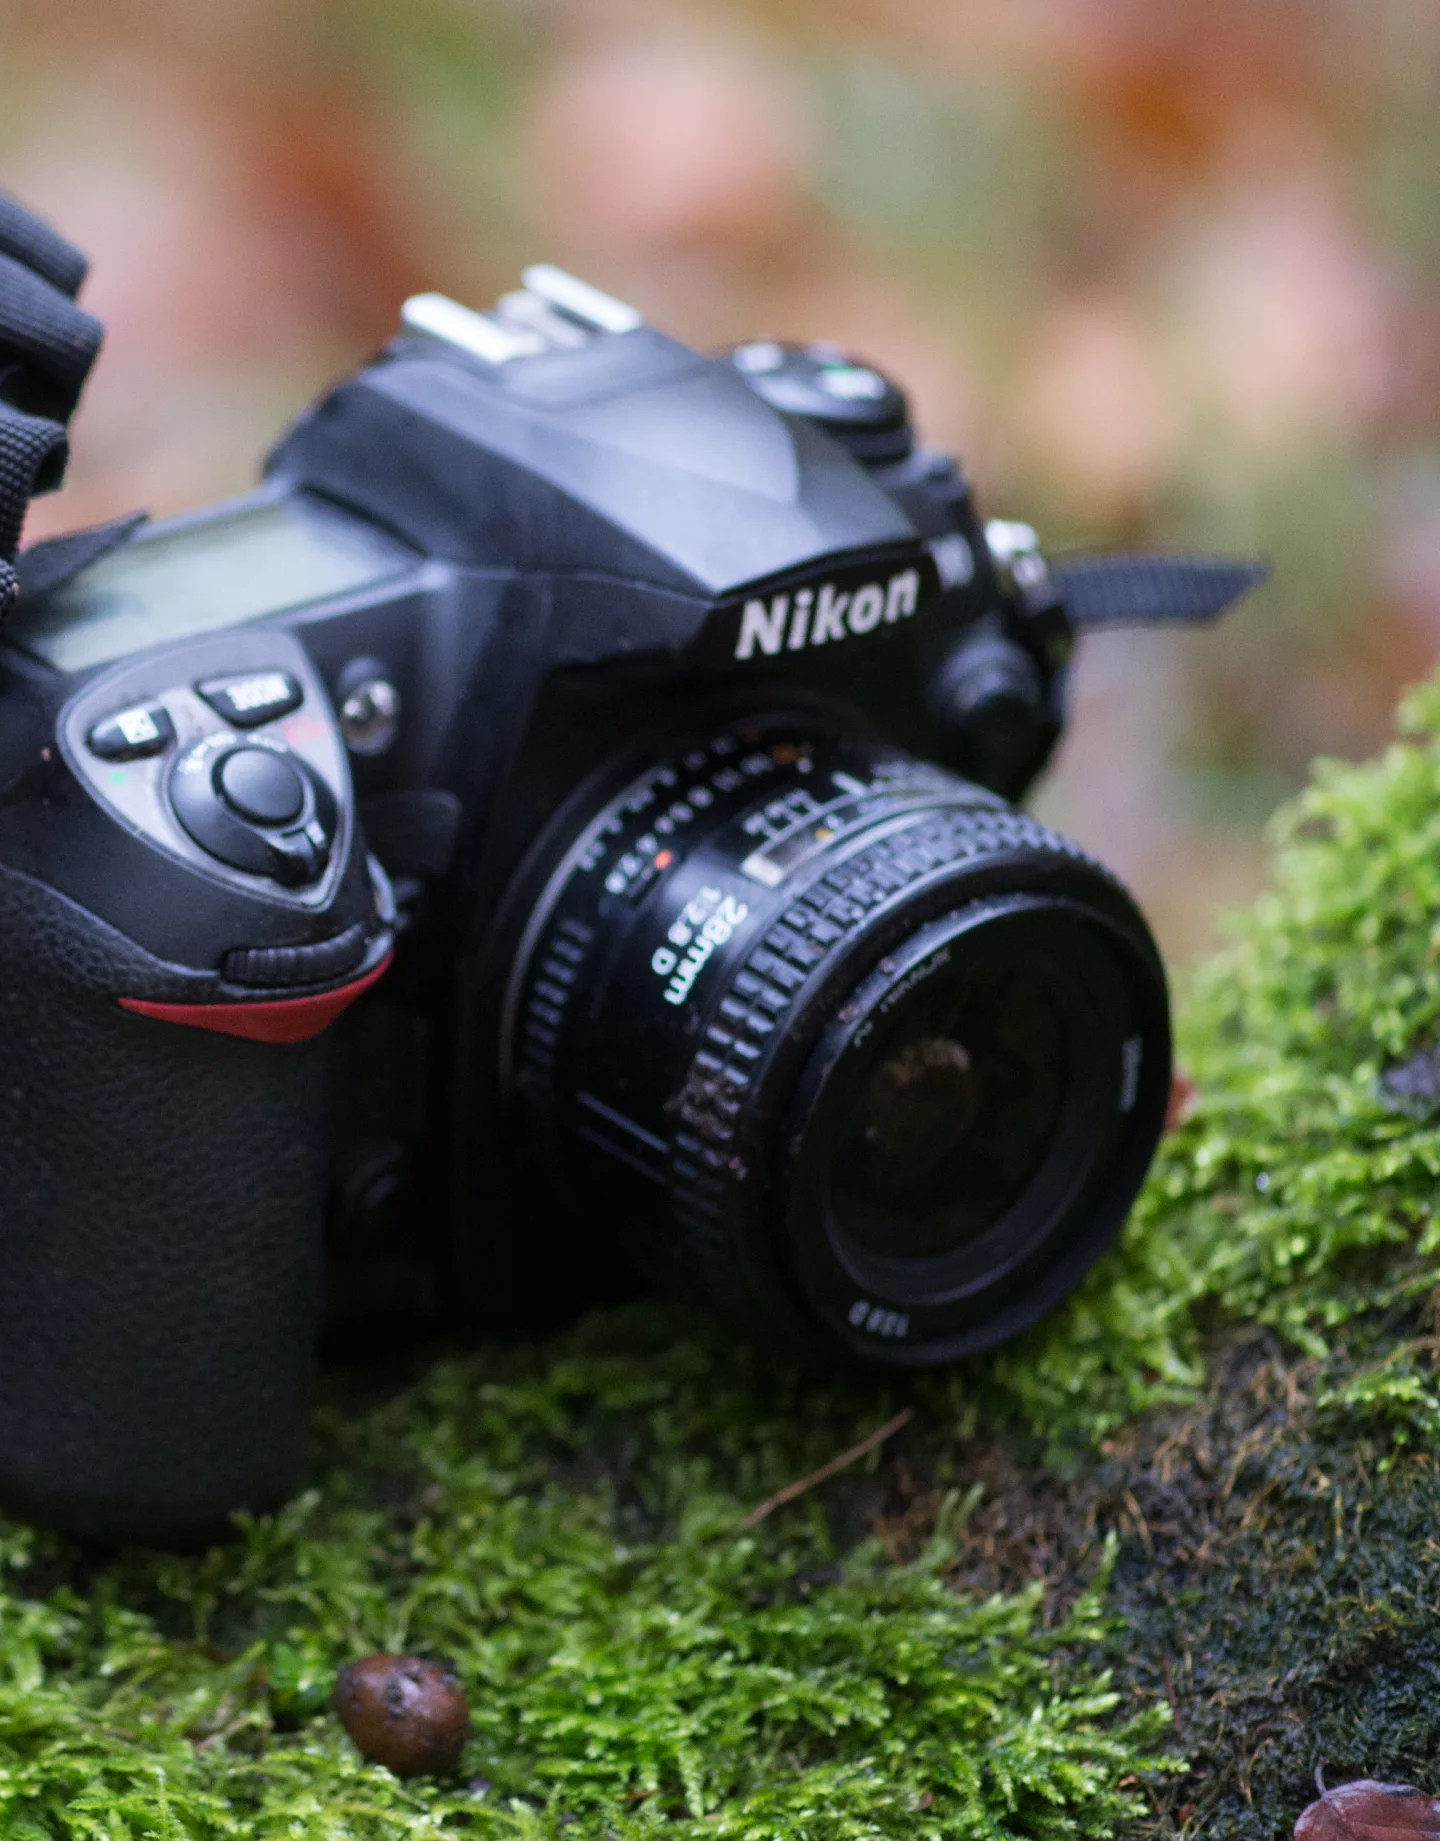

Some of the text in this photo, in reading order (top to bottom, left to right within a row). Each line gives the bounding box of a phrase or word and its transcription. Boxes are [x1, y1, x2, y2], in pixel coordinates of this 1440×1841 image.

[734, 567, 920, 661] Nikon
[651, 946, 678, 976] D
[663, 895, 748, 1005] 28mm
